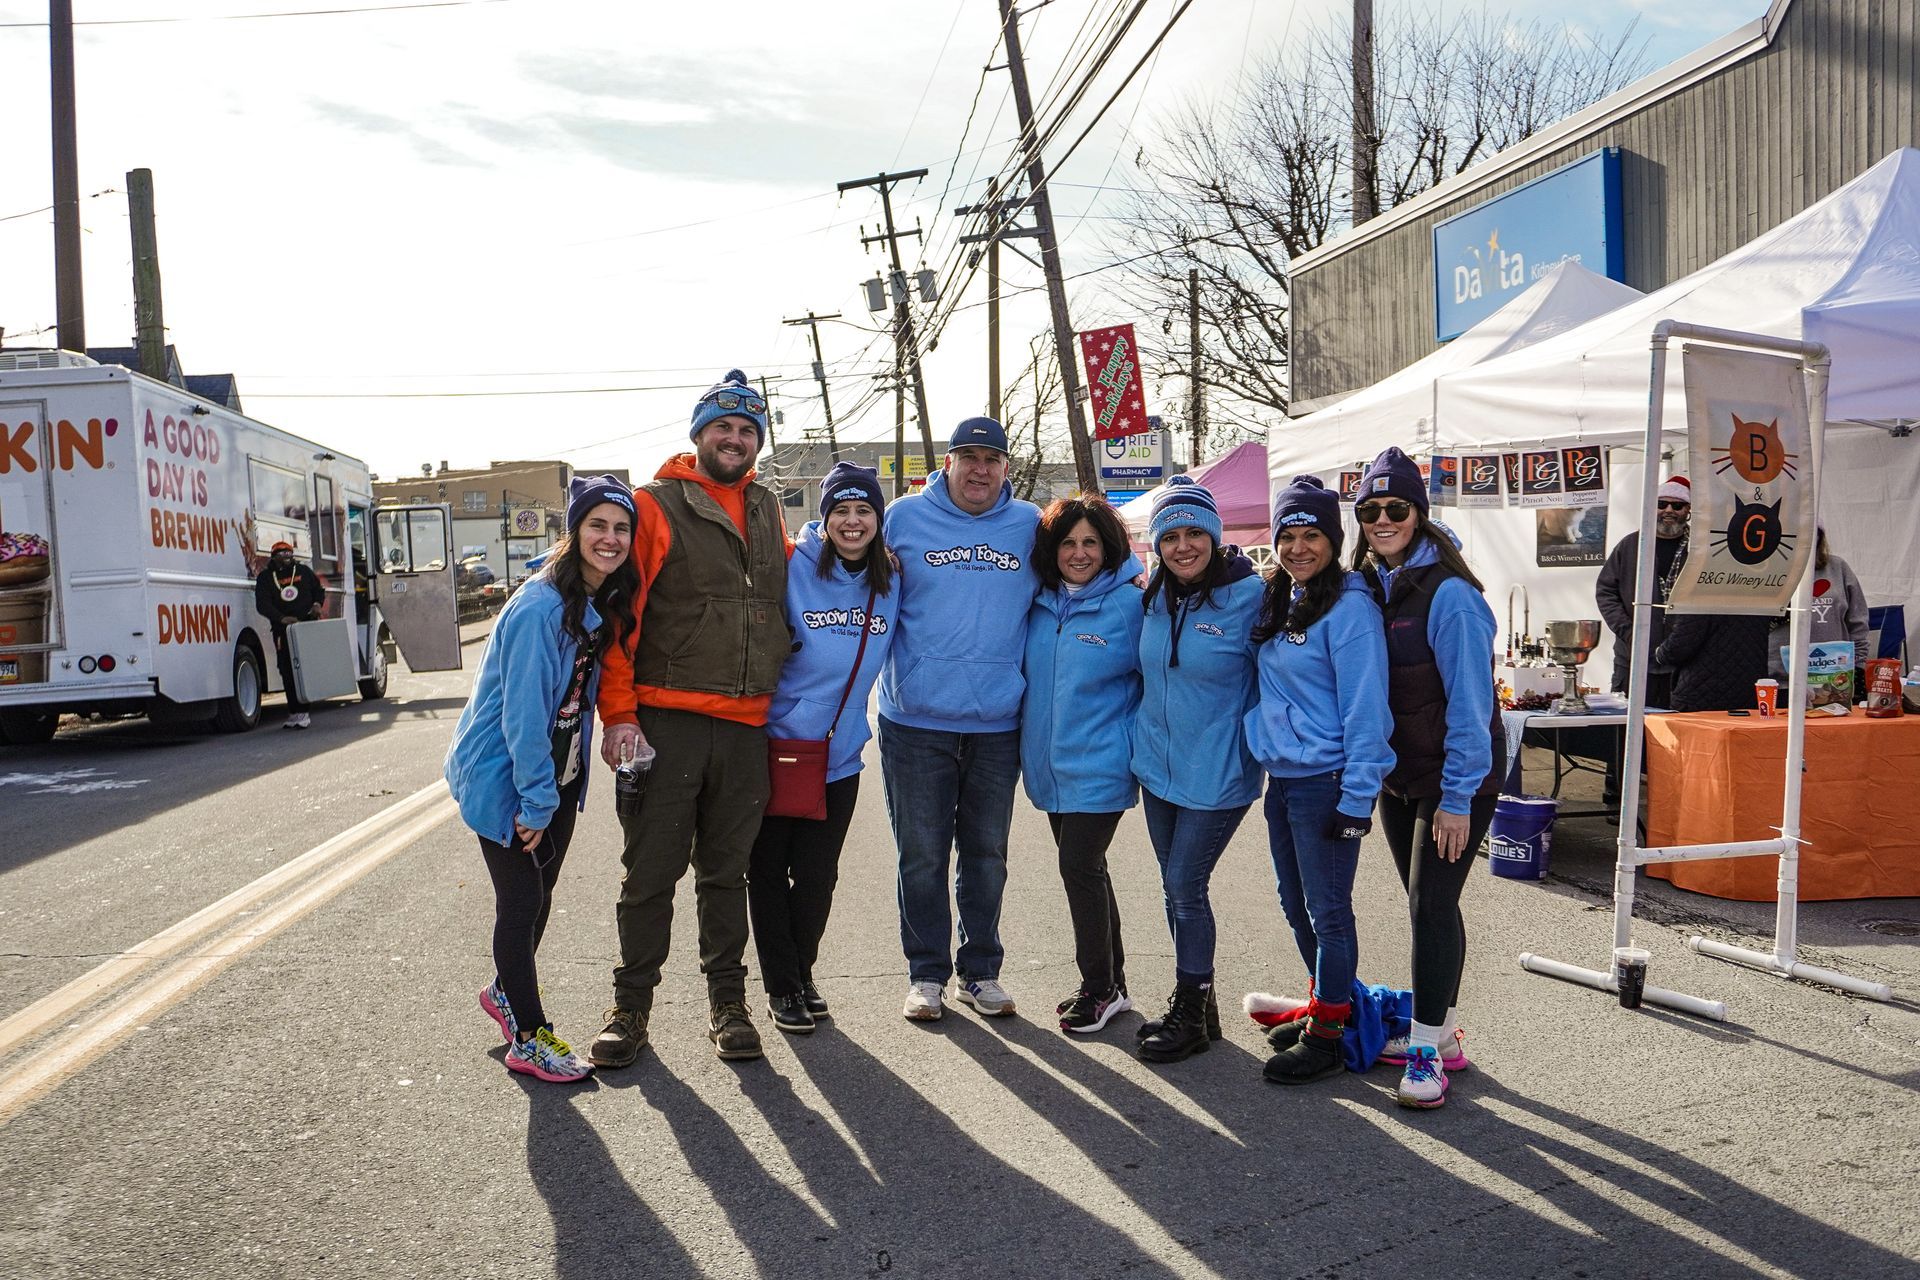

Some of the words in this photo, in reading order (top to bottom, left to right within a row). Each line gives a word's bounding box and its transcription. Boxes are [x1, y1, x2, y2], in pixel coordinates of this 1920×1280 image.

[1097, 335, 1130, 388] Happy
[1097, 360, 1135, 429] Holidays
[144, 408, 158, 450] A
[163, 415, 221, 465] GOOD
[1129, 434, 1158, 446] RITE
[1128, 446, 1151, 458] AID
[1750, 433, 1768, 472] B
[147, 458, 185, 502] DAY
[191, 468, 208, 507] IS
[1753, 486, 1763, 501] &
[151, 508, 228, 555] BREWIN'
[1743, 514, 1766, 553] G
[924, 546, 973, 567] Snow
[974, 543, 1021, 571] Forge
[1557, 554, 1582, 563] Winery
[1697, 571, 1726, 585] B&G
[1726, 573, 1764, 590] Winery
[1765, 574, 1788, 588] LLC
[1811, 597, 1833, 605] AND
[158, 603, 231, 645] DUNKIN'
[803, 607, 849, 630] Snow
[850, 605, 889, 636] Foge
[1, 664, 15, 675] 994
[1807, 657, 1836, 671] udges
